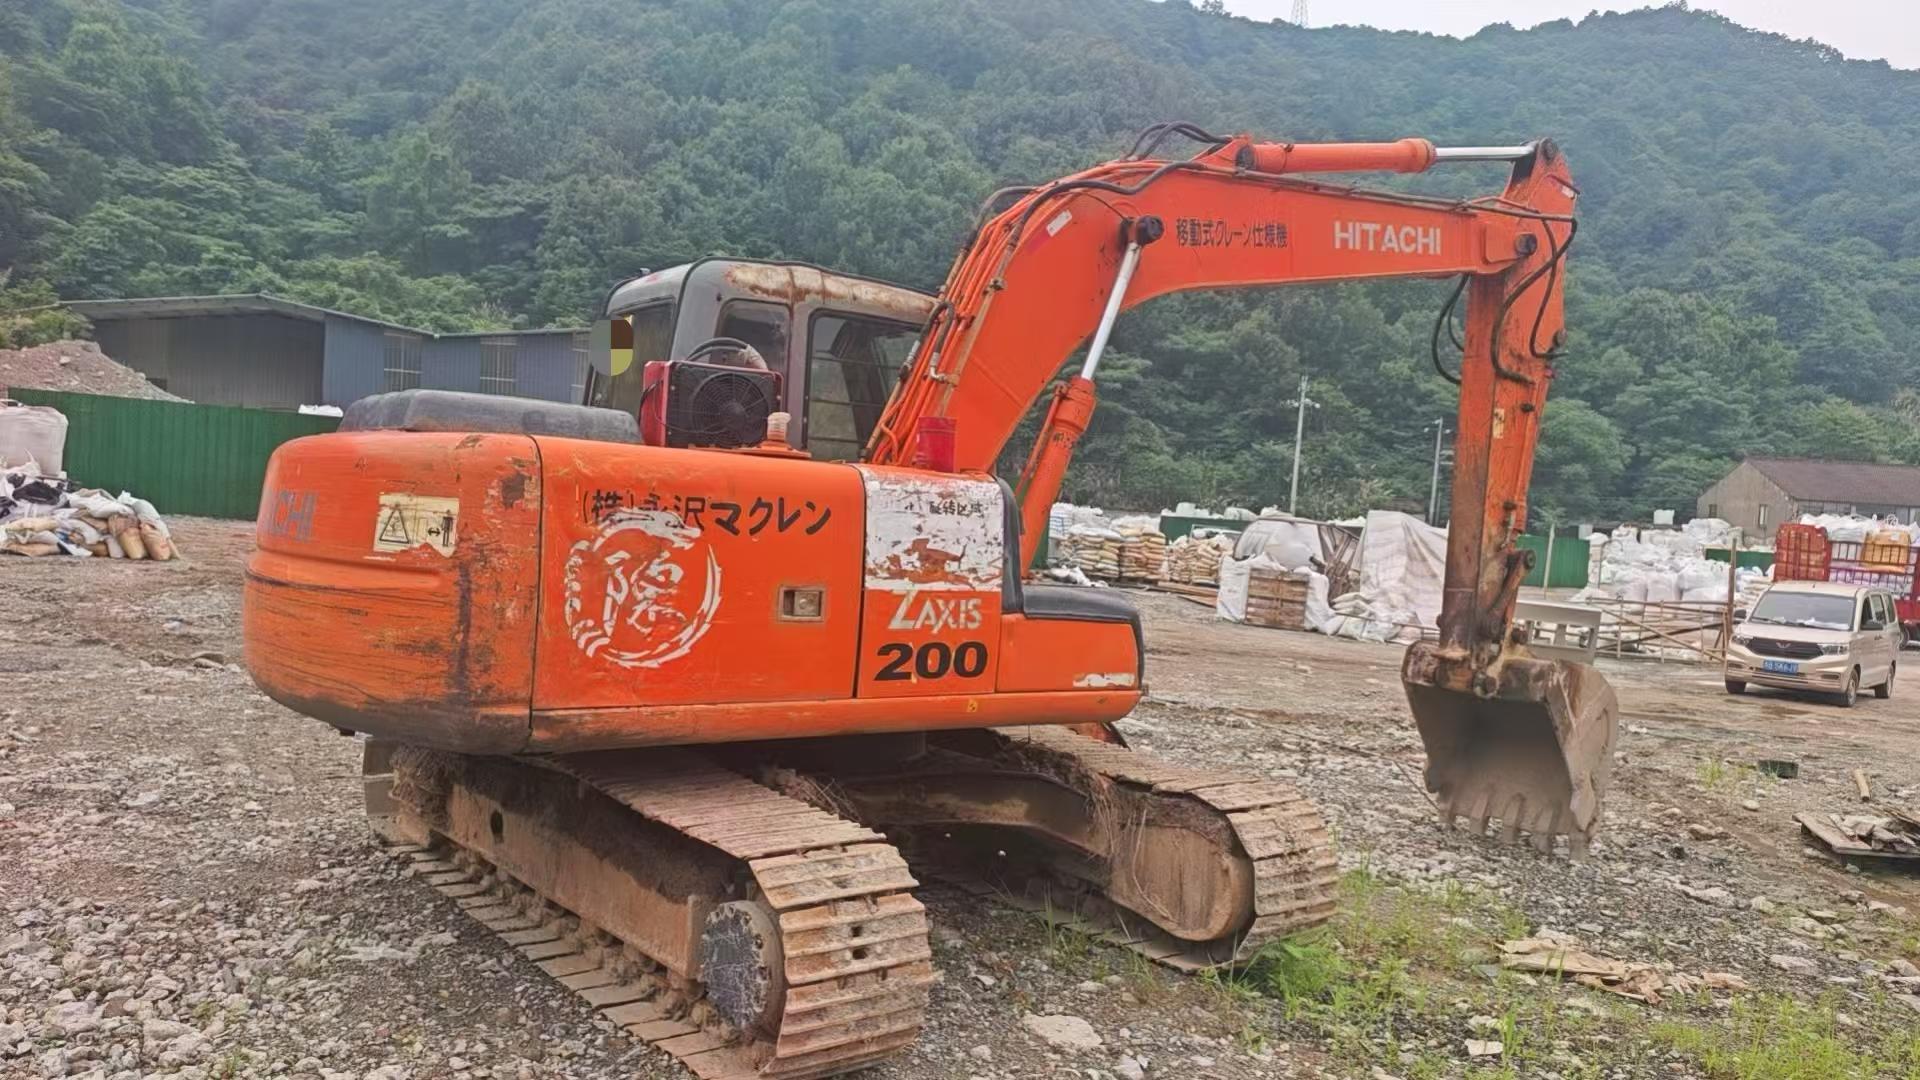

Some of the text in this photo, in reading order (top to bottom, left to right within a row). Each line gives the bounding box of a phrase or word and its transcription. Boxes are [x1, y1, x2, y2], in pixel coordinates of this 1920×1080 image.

[1334, 221, 1441, 256] HITACHI
[887, 587, 983, 634] ZAXIS
[874, 641, 988, 681] 200
